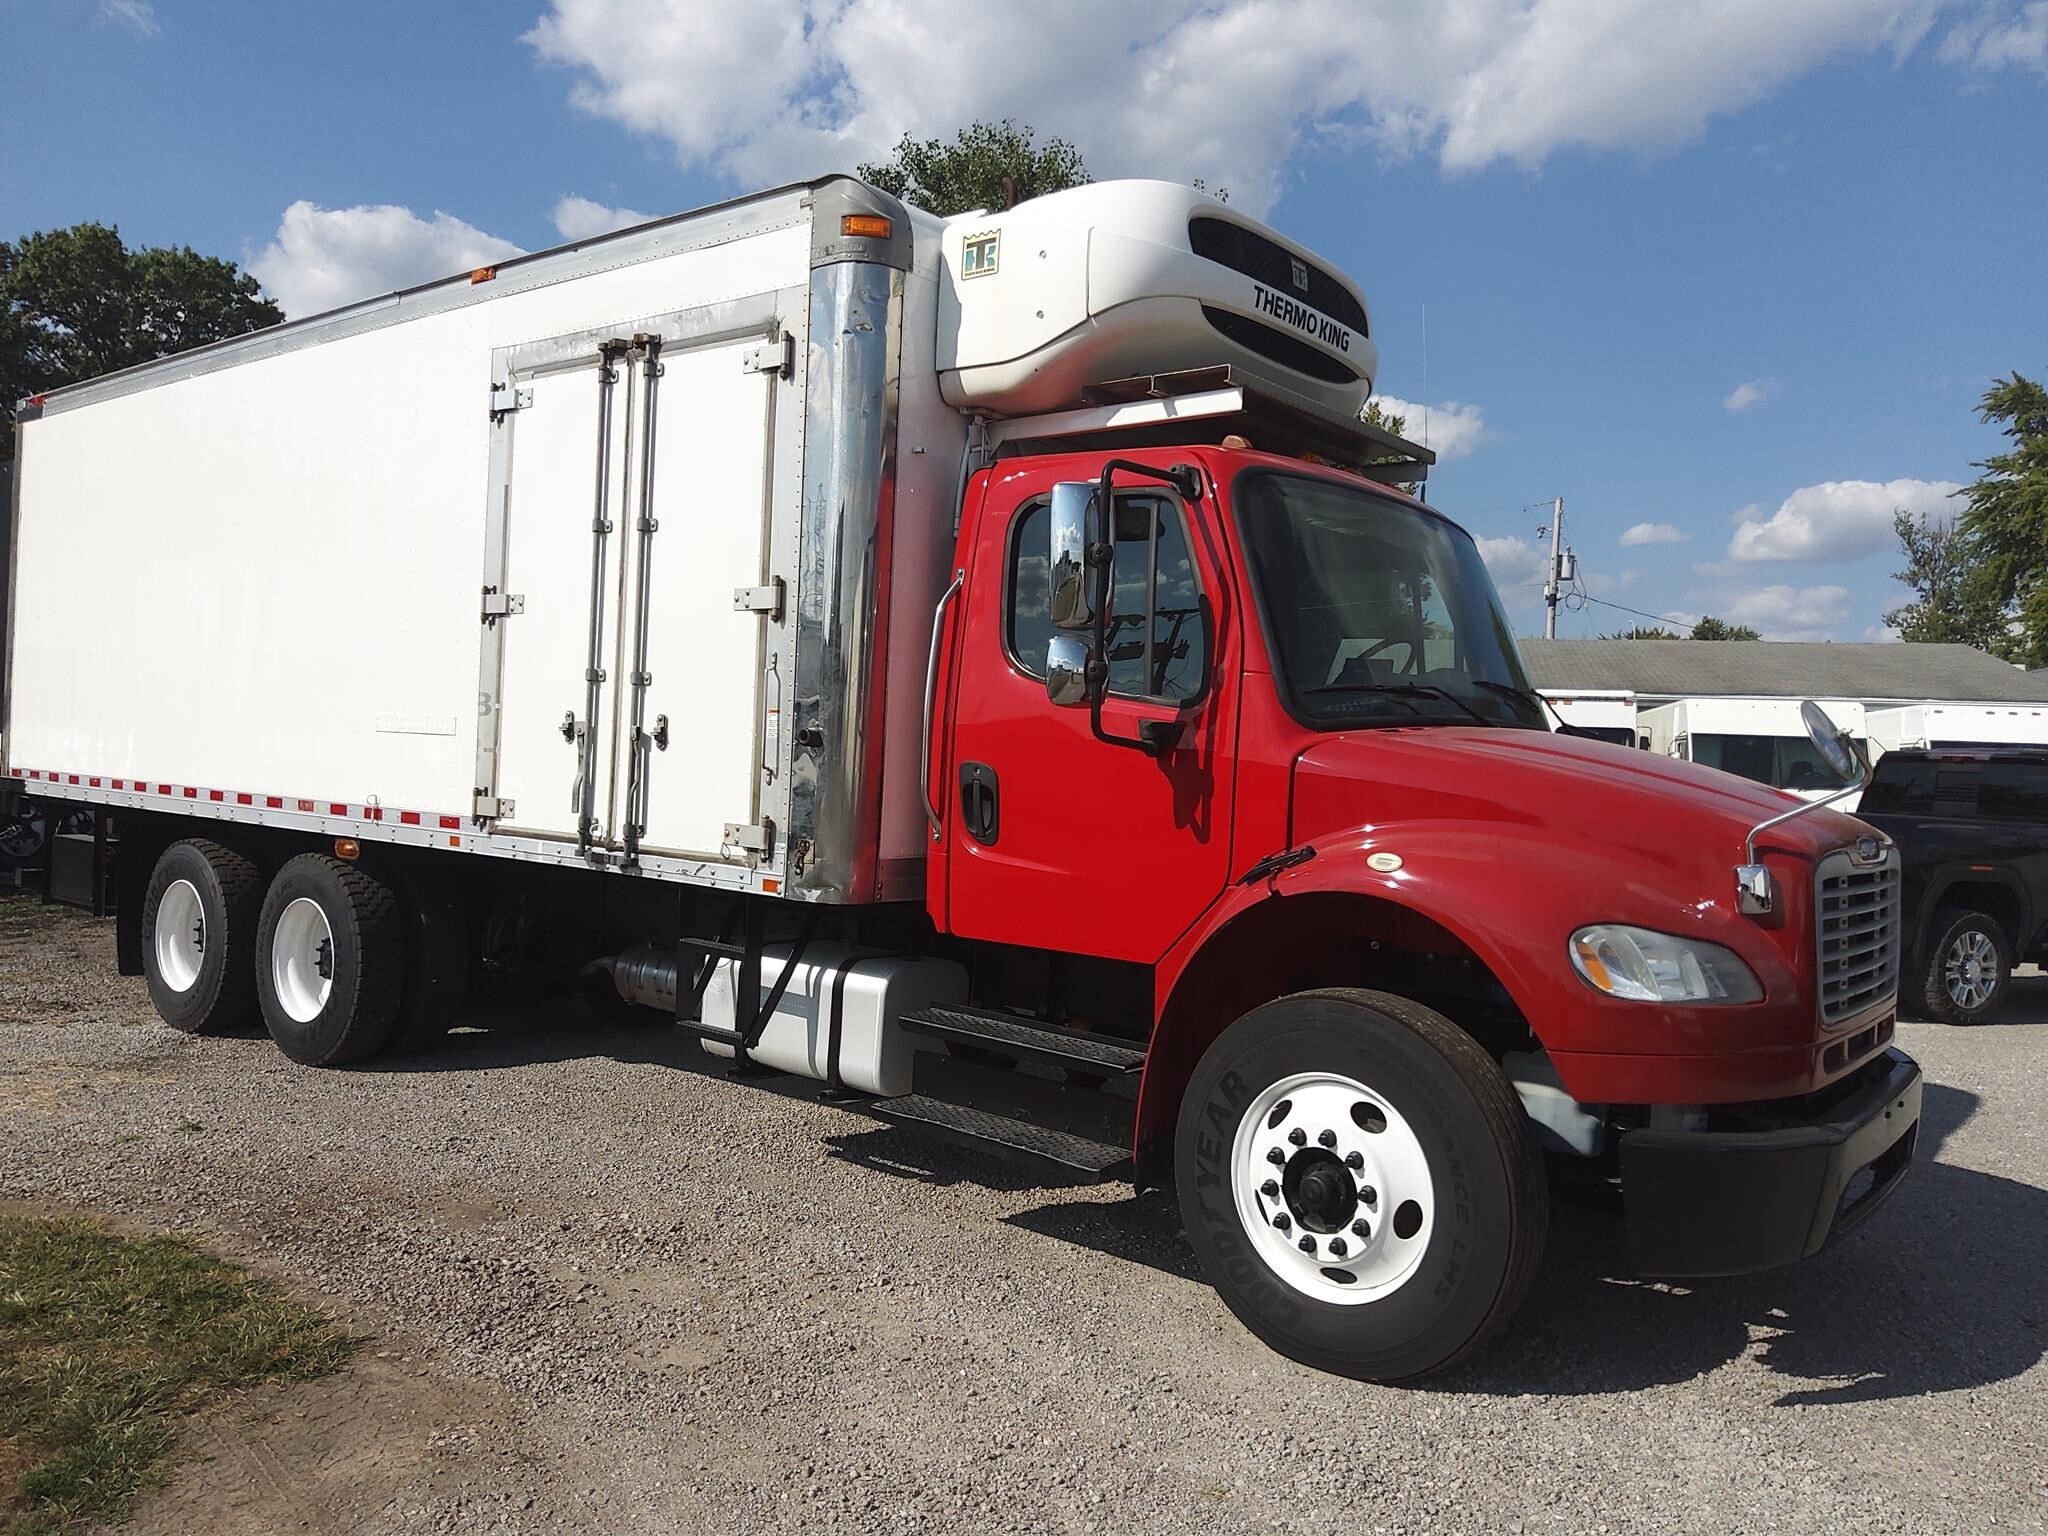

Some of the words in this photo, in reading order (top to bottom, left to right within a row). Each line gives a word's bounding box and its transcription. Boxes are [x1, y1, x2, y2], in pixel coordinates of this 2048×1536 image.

[1253, 284, 1318, 335] THERMO
[1318, 318, 1350, 353] KING
[1196, 1069, 1302, 1329] GOODYEAR
